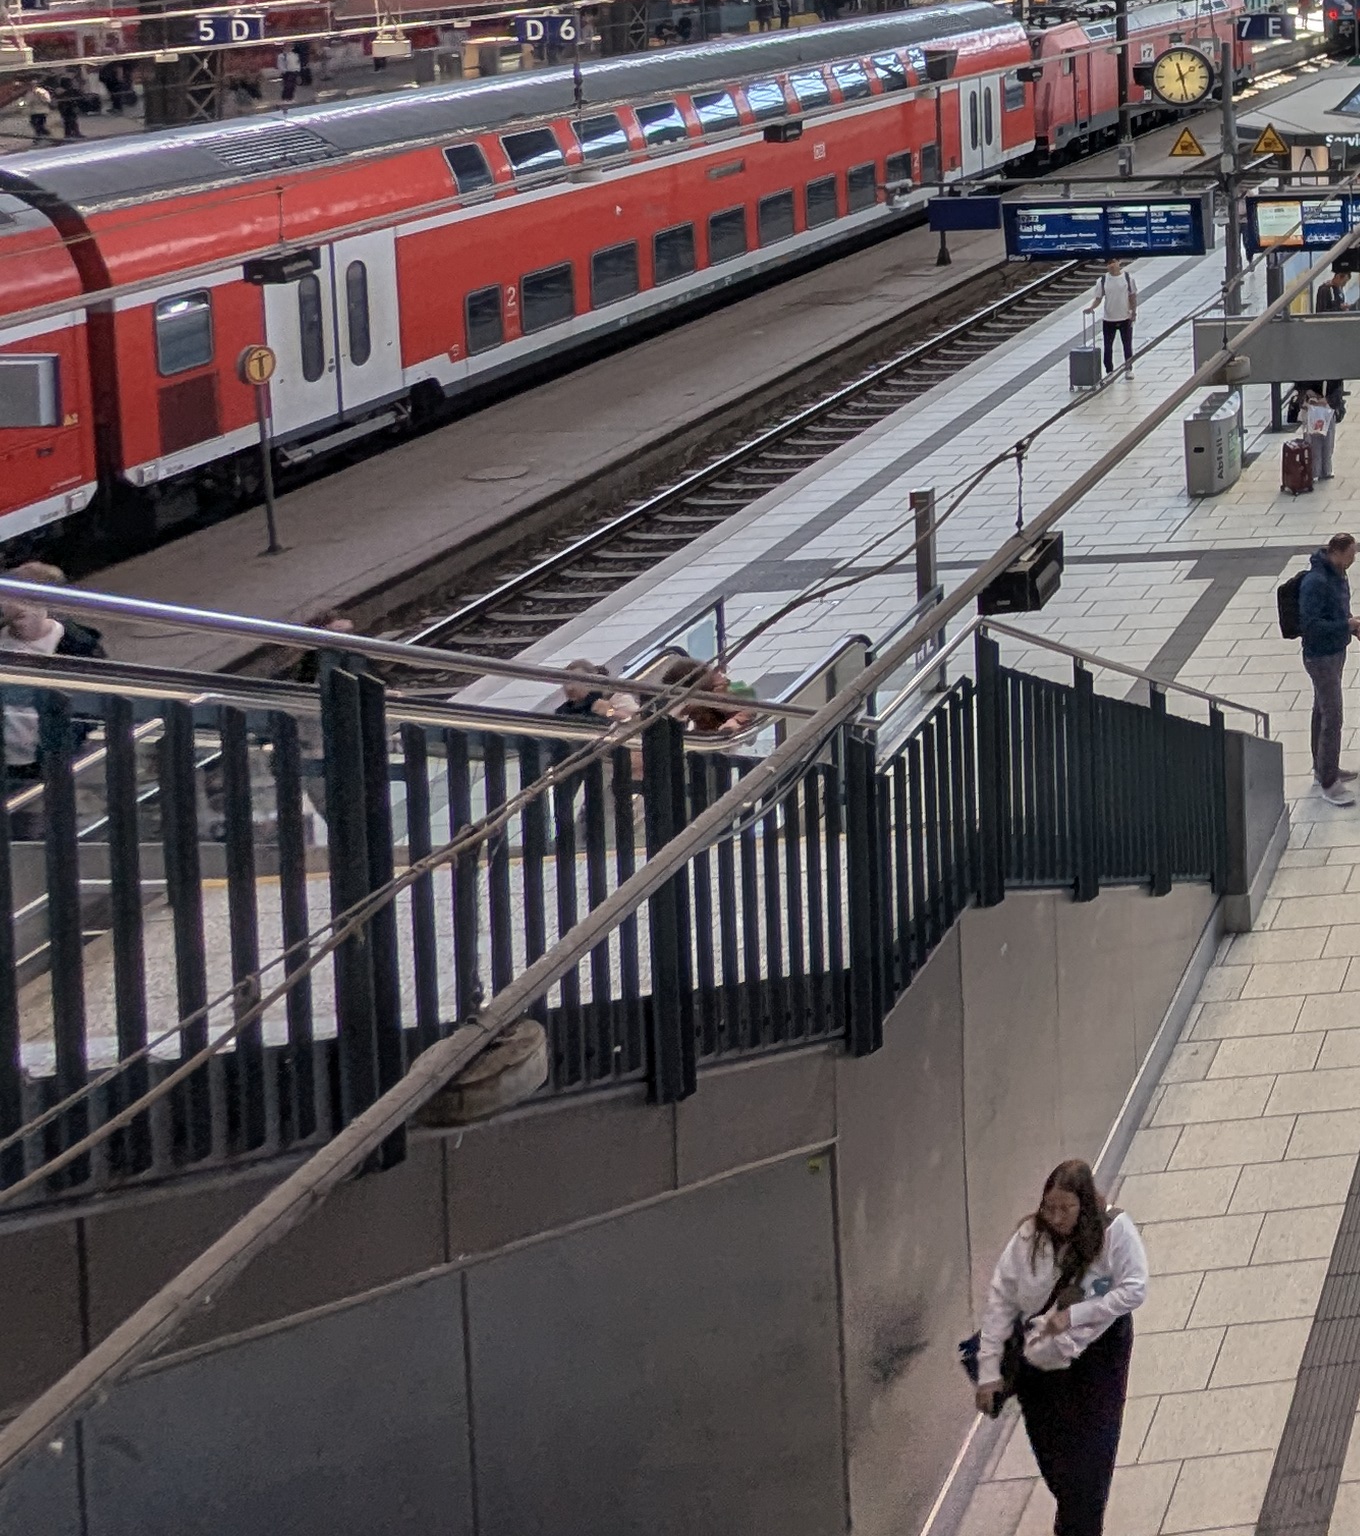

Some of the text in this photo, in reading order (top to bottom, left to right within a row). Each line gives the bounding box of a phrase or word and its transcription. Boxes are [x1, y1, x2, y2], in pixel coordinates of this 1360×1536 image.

[200, 20, 250, 41] 5 D
[526, 19, 576, 41] D 6
[1240, 17, 1282, 38] 7 E
[507, 286, 516, 307] 2
